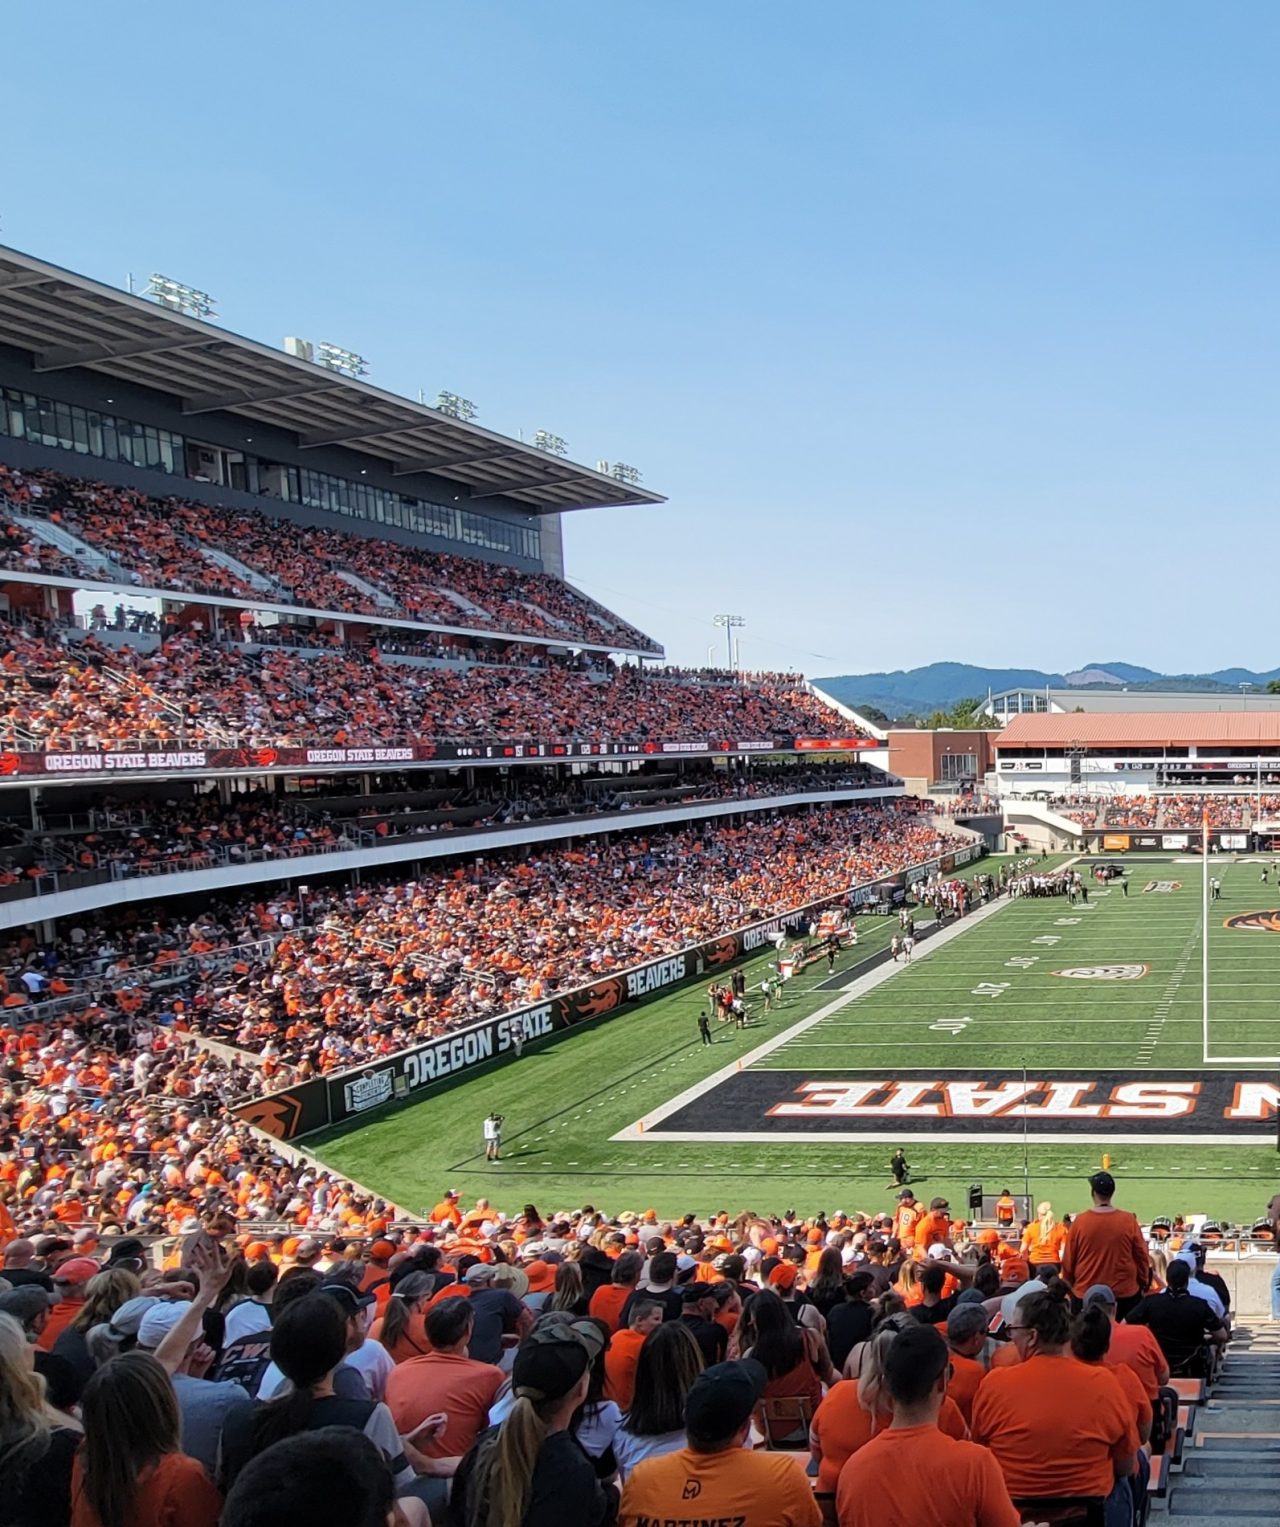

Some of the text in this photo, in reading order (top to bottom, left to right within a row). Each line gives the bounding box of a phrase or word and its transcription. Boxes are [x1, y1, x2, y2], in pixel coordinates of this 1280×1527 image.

[45, 752, 206, 770] OREGON STATE BEAVERS
[307, 748, 413, 762] OREGON STATE BEAVERS
[627, 955, 685, 998] BEAVERS
[971, 982, 1011, 996] 20
[929, 1016, 973, 1031] 10
[403, 1027, 493, 1088] OREGON
[765, 1081, 1201, 1119] STATE
